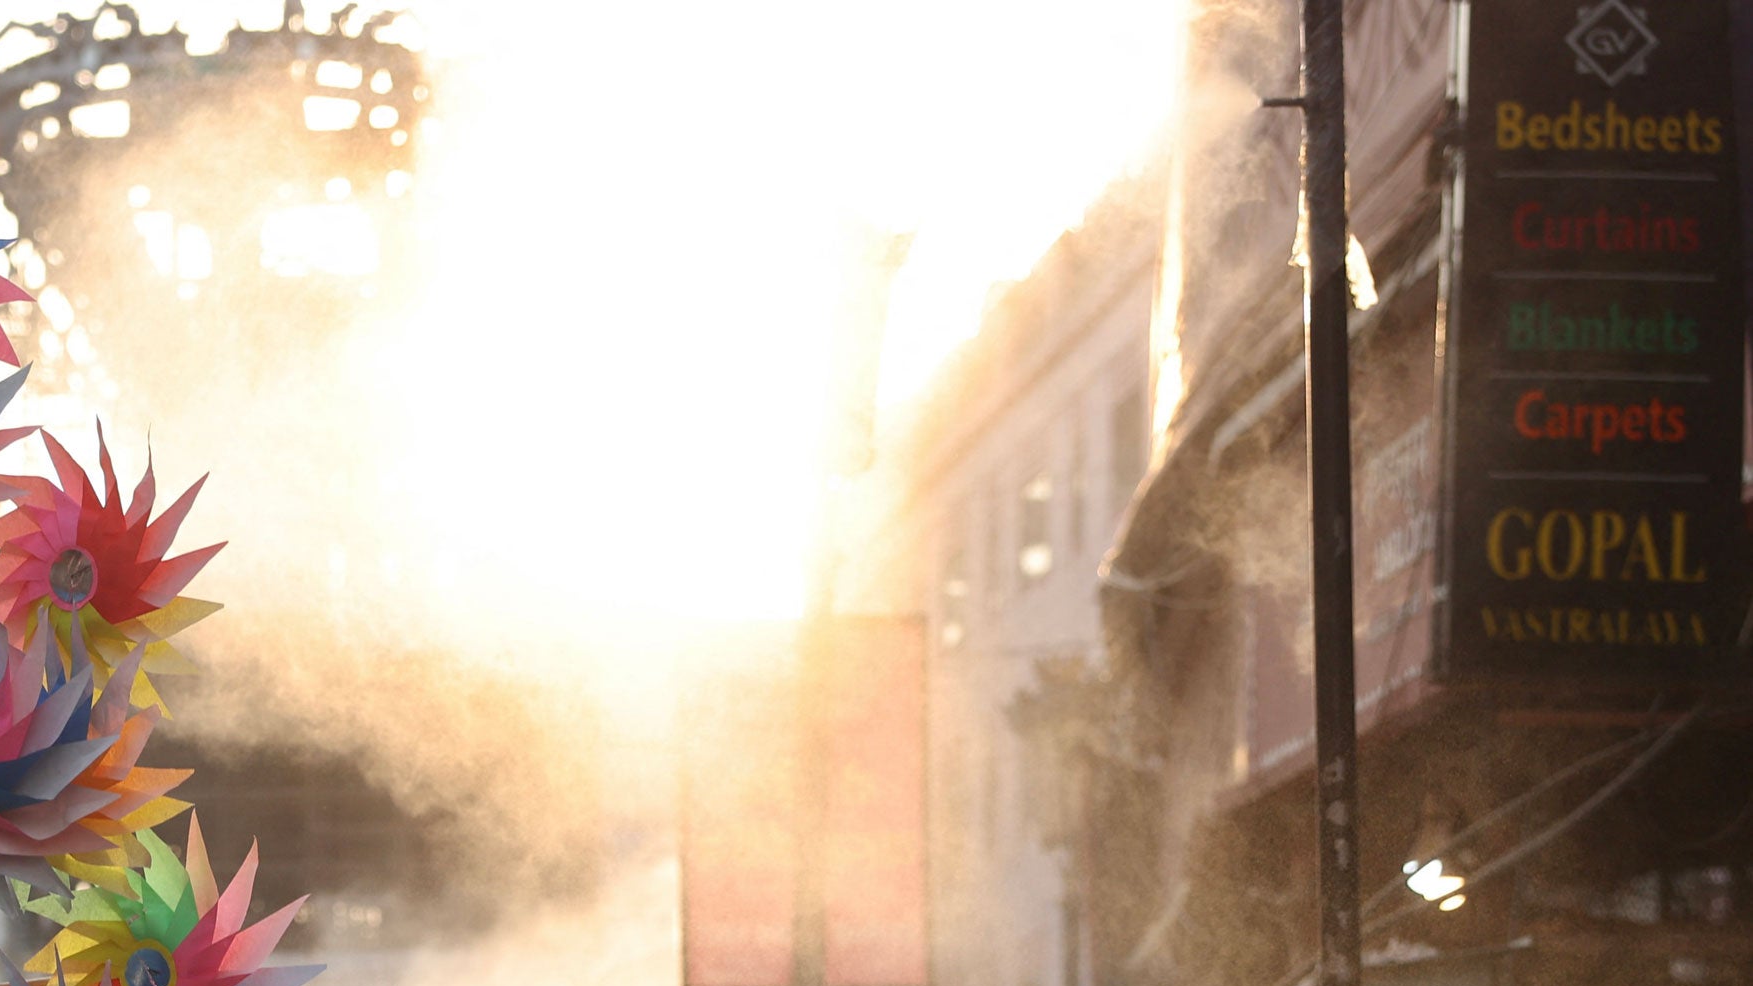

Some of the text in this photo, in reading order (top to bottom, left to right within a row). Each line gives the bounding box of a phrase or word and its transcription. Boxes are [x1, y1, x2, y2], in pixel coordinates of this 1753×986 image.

[1497, 100, 1723, 154] Bedsheets
[1512, 202, 1701, 255] Curtains
[1507, 302, 1700, 354] Blankets
[1514, 389, 1687, 454] Carpets
[1485, 506, 1707, 583] GOPAL
[1480, 605, 1707, 646] VASTRALAYA
